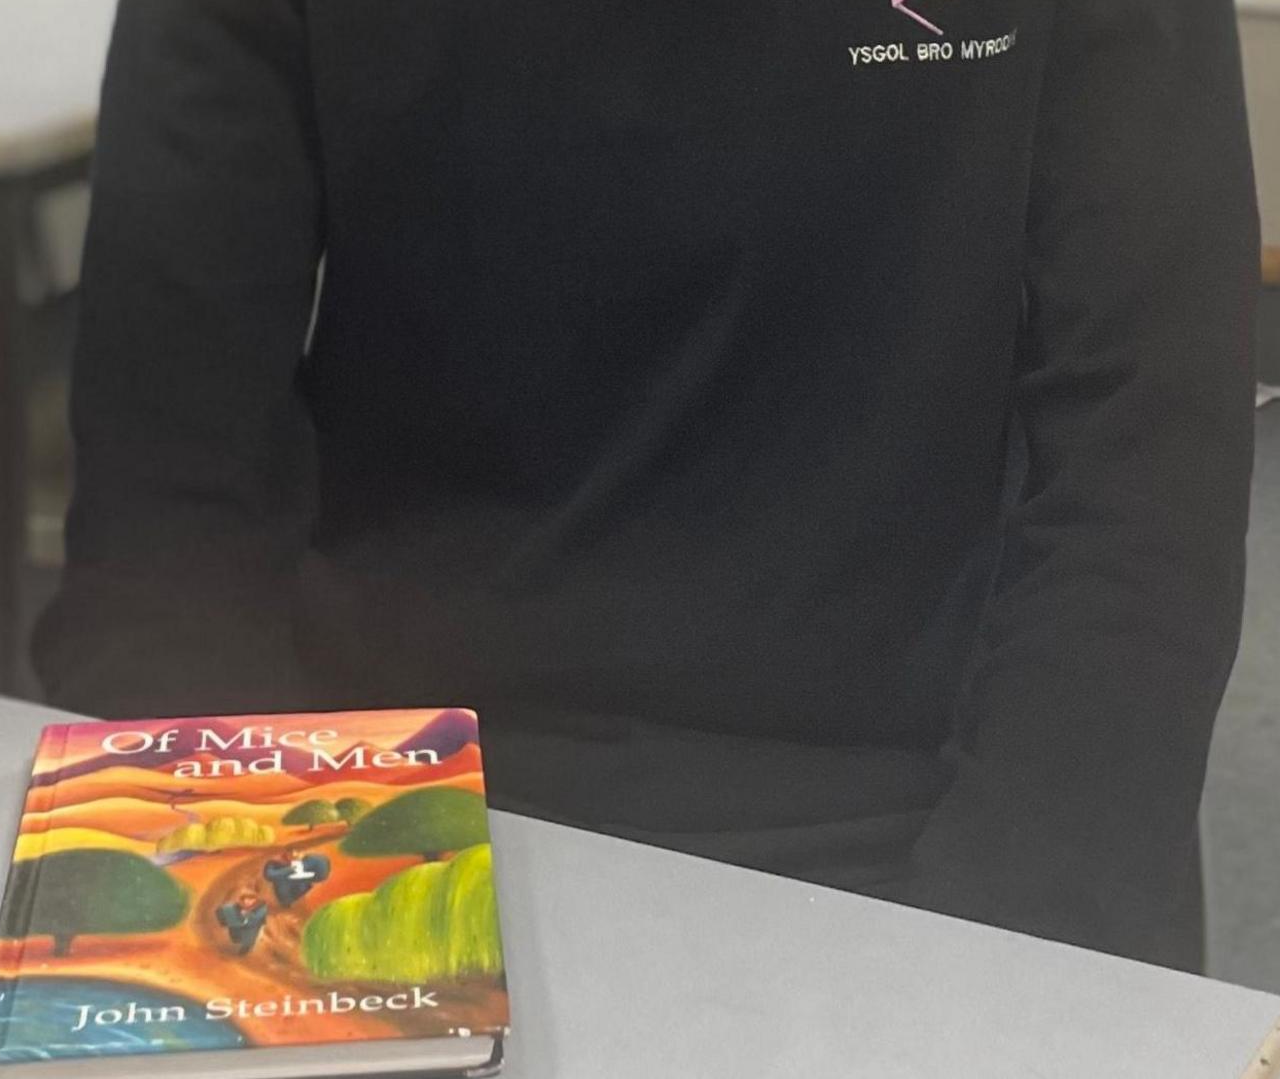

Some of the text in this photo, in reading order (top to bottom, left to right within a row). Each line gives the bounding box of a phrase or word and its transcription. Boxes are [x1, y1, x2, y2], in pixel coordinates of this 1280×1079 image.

[848, 43, 909, 65] YSGOL
[917, 42, 953, 60] BRO
[101, 726, 338, 754] Of Mice
[173, 746, 442, 779] and Men
[72, 986, 438, 1031] John Steinbeck
